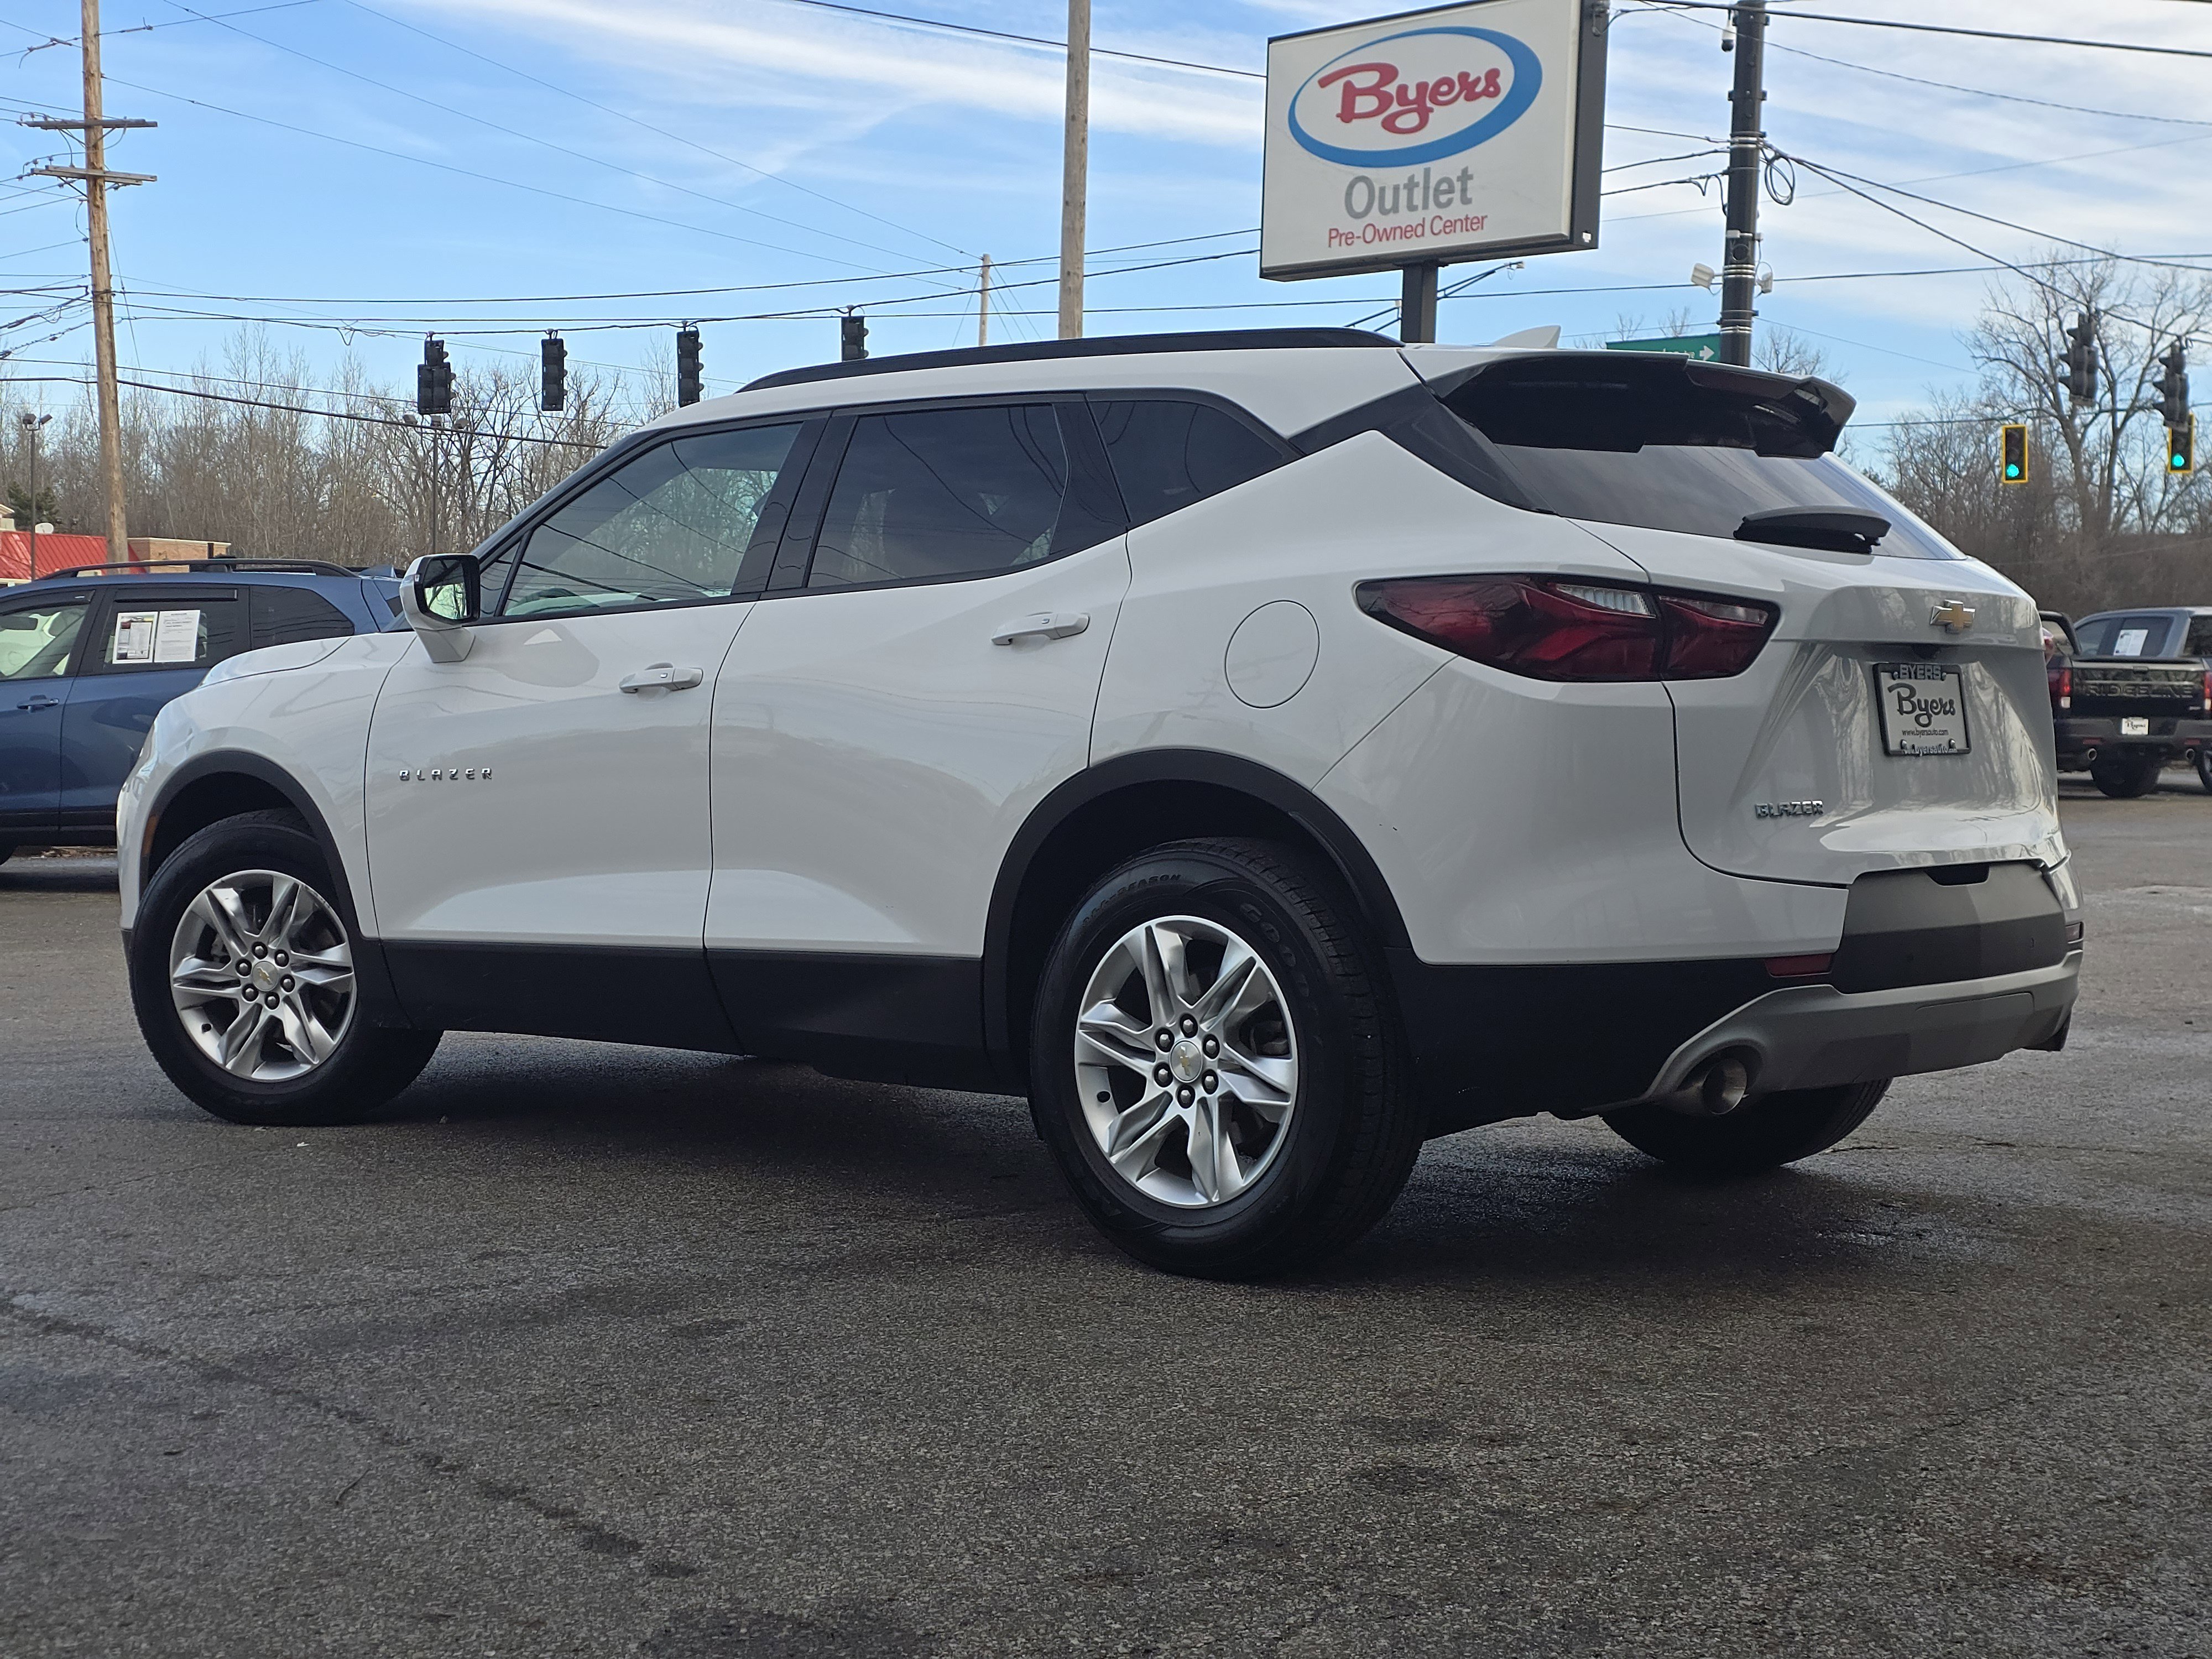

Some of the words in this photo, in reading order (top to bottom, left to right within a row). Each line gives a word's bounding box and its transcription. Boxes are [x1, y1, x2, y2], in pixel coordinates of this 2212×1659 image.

[1318, 62, 1501, 134] Byers
[1344, 166, 1474, 219] Outlet
[1328, 218, 1425, 248] Pre-Owned
[1430, 213, 1488, 237] Center
[1899, 664, 1942, 680] BYERS
[1887, 682, 1957, 728] Byers
[399, 767, 492, 781] BLAZER
[1755, 800, 1824, 818] BLAZER
